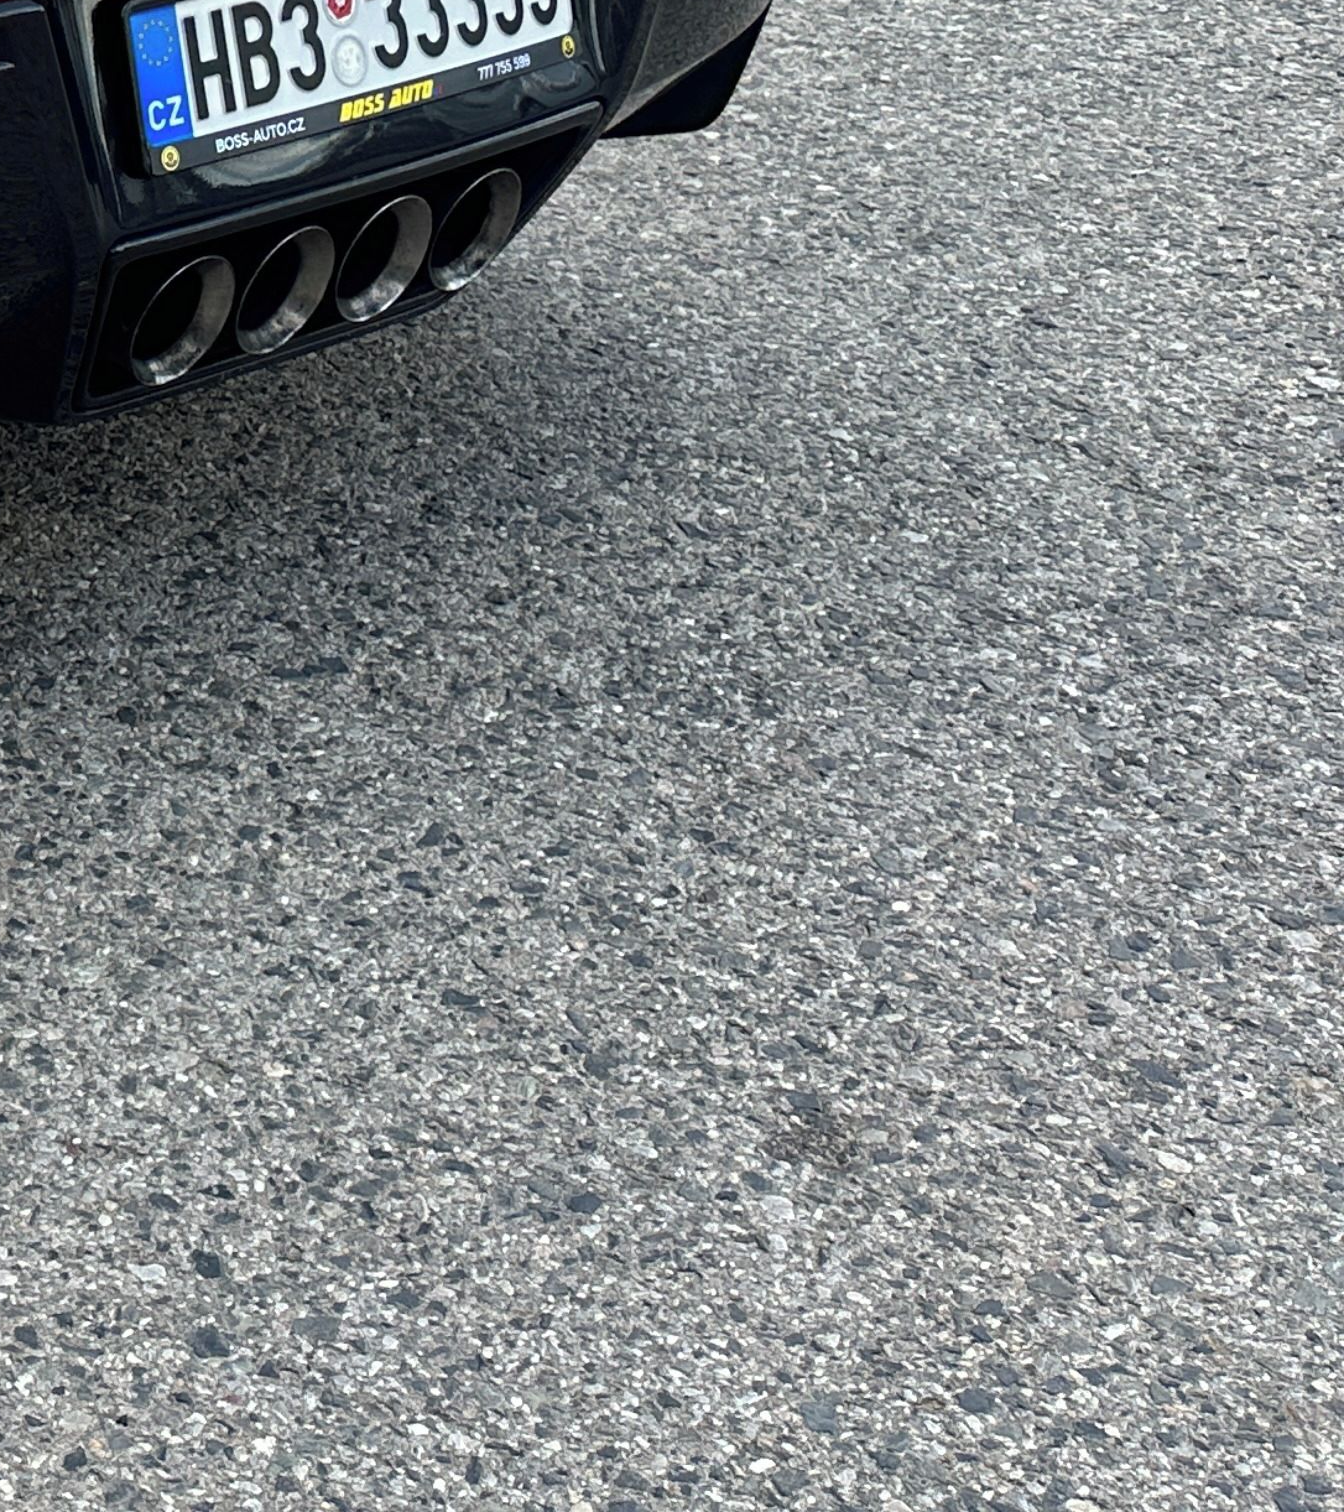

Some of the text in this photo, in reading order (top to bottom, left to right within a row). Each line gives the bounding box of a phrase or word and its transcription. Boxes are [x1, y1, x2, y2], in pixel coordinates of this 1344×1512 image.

[477, 64, 493, 81] 777
[495, 58, 513, 76] 755
[148, 95, 185, 131] CZ
[339, 79, 435, 123] BOSS AUTO
[215, 117, 307, 153] BOSS-AUTO.CZ
